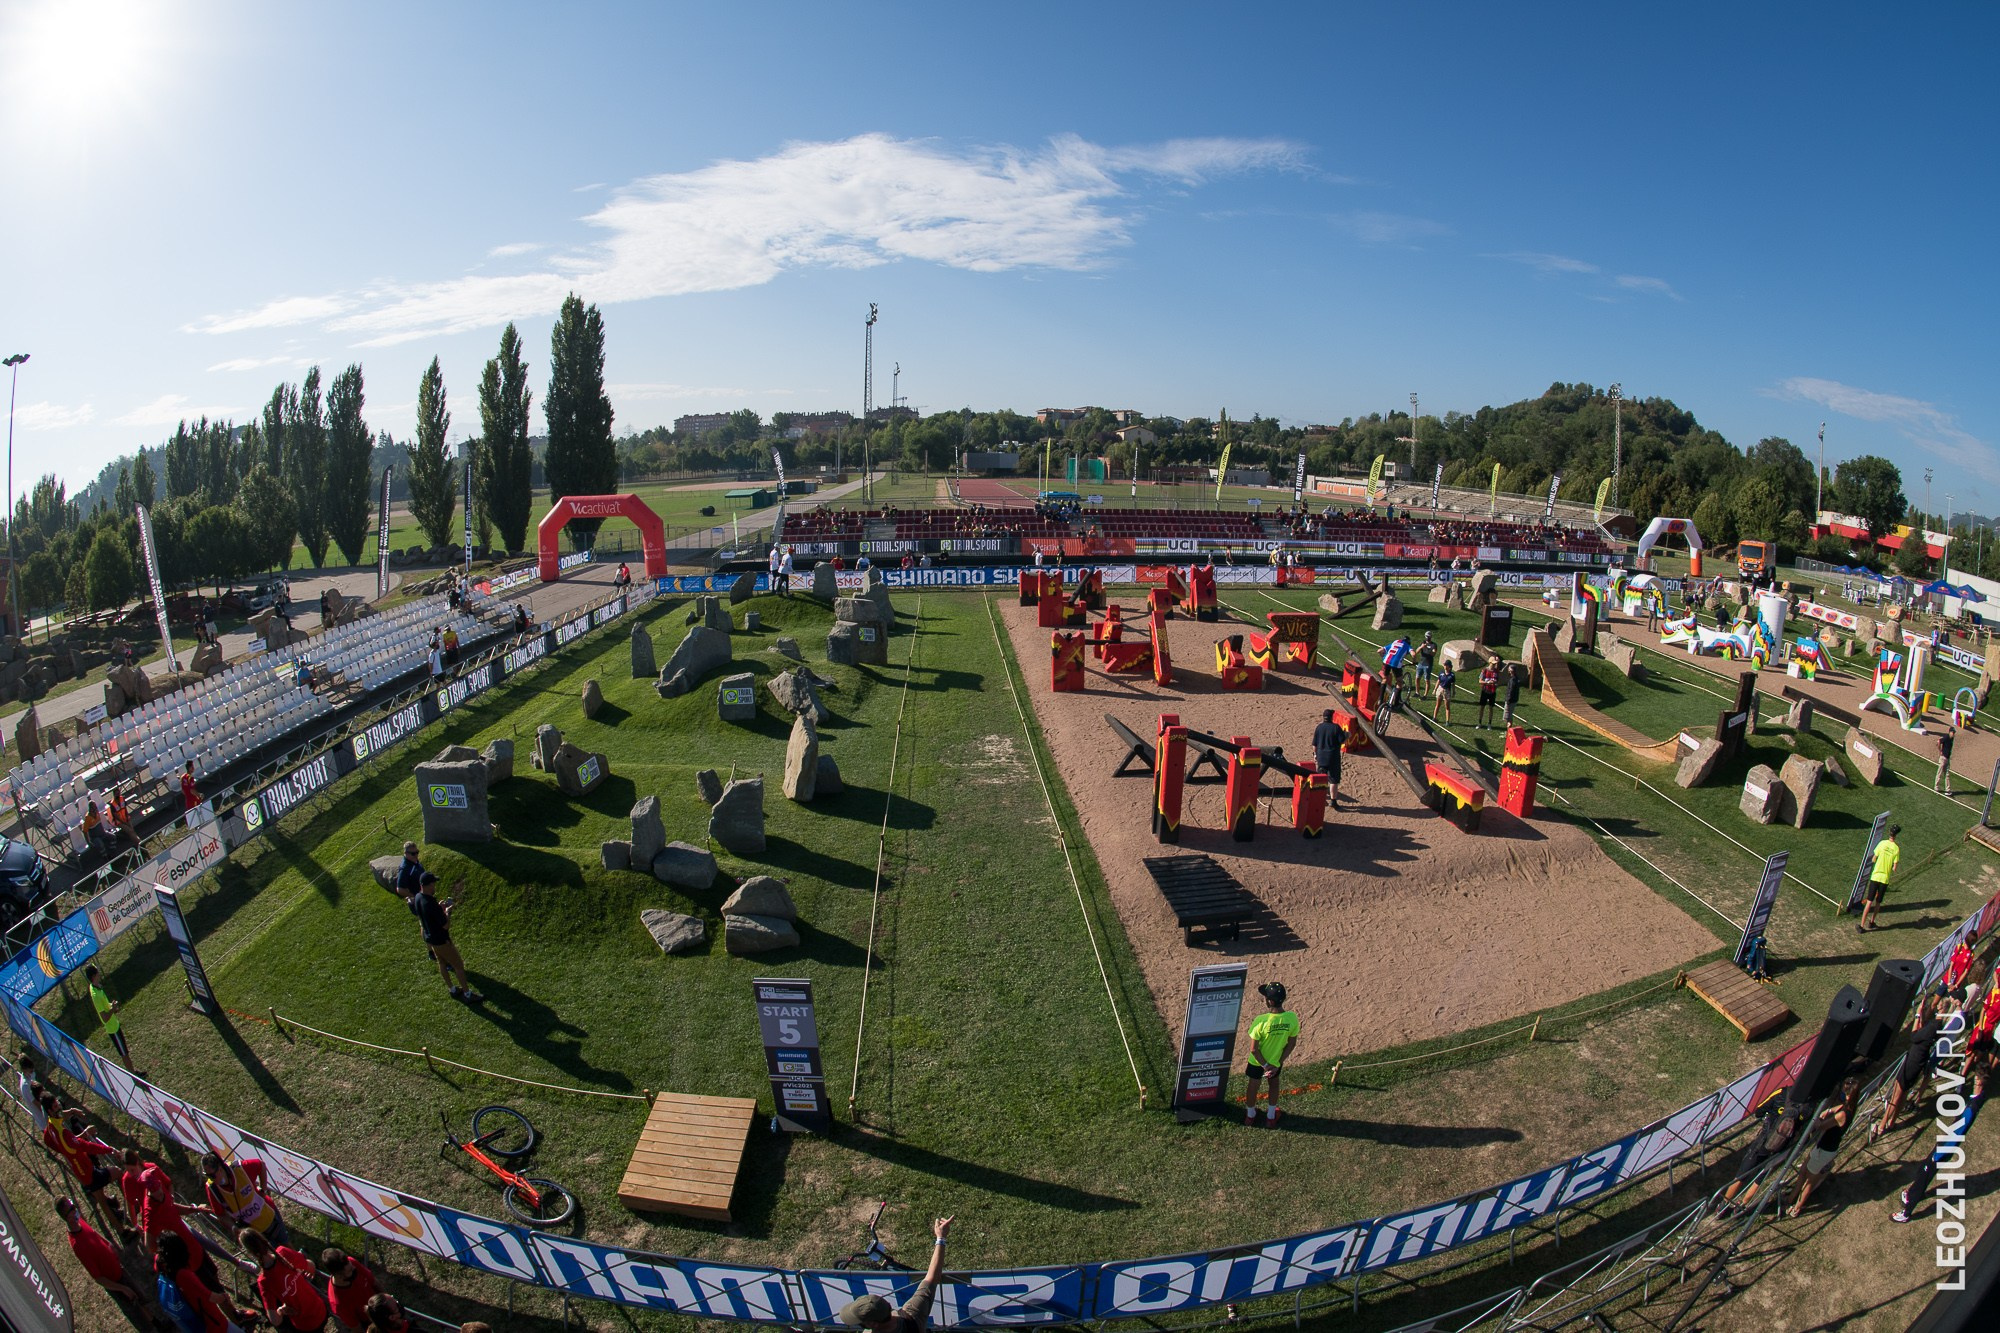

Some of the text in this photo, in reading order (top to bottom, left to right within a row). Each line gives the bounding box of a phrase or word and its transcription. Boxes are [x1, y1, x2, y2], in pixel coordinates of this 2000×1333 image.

[1296, 454, 1306, 490] TRIALSPORT
[872, 540, 920, 552] TRIALSPORT
[953, 540, 1001, 551] TRIALSPORT
[1168, 540, 1193, 551] UCI
[1337, 543, 1358, 554] UCI
[887, 569, 985, 586] SHIMANO
[1428, 571, 1450, 582] UCI
[1502, 574, 1520, 584] UCI
[561, 614, 590, 645] TRIALSPORT
[511, 636, 547, 669] TRIALSPORT
[1800, 644, 1814, 655] UCI
[1953, 650, 1971, 667] UCI
[447, 664, 492, 706] TRIALSPORT
[365, 703, 421, 752] TRIALSPORT
[586, 757, 598, 772] TRIAL
[588, 767, 600, 781] SPORT
[260, 756, 329, 820] TRIALSPORT
[447, 786, 465, 797] TRIAL
[449, 796, 466, 807] SPORT
[170, 837, 220, 881] esportcat
[107, 884, 143, 914] Generalitat
[1764, 881, 1775, 901] 4
[112, 892, 152, 925] de Catalunya
[1196, 993, 1232, 1002] SECTION
[763, 1006, 809, 1017] START
[779, 1019, 801, 1044] 5
